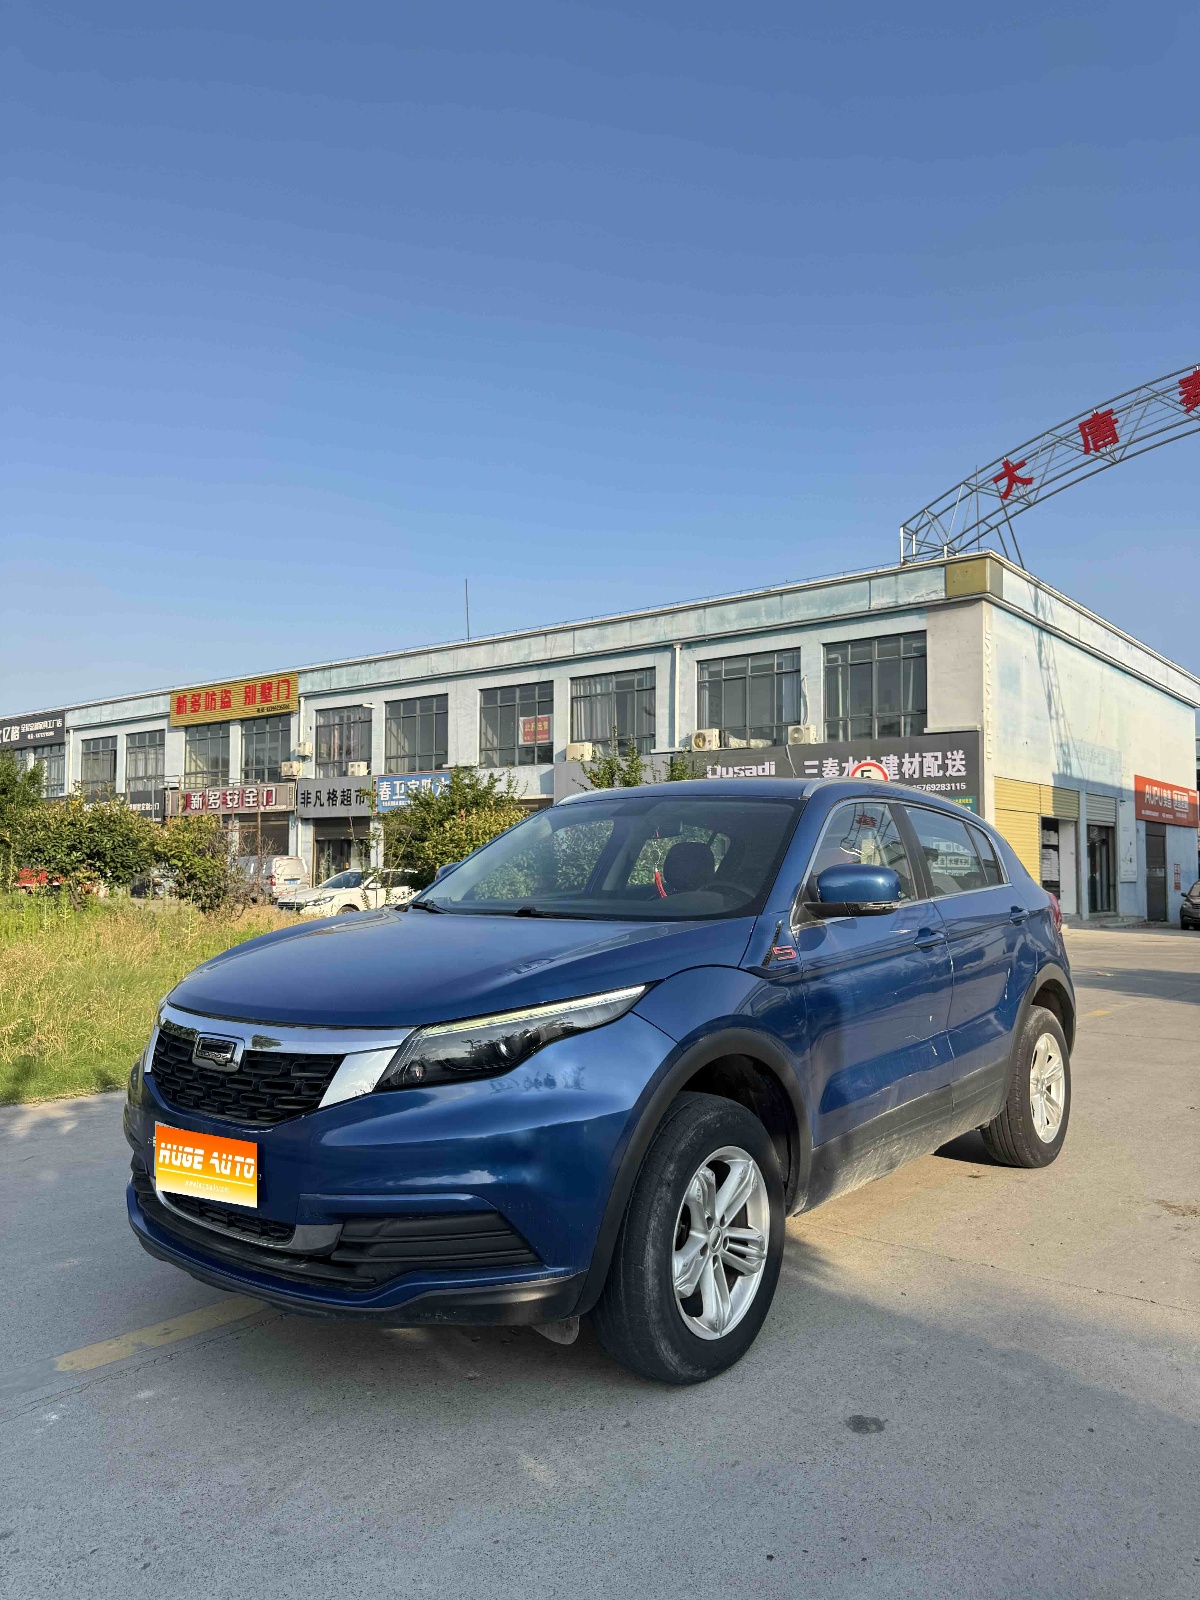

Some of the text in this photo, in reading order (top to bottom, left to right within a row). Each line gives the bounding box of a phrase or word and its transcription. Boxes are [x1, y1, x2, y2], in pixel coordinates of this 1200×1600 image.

[175, 689, 232, 715] 新多防盗
[244, 679, 291, 706] 别墅门
[190, 787, 277, 810] 新多安全门
[300, 786, 367, 808] 非凡格超市
